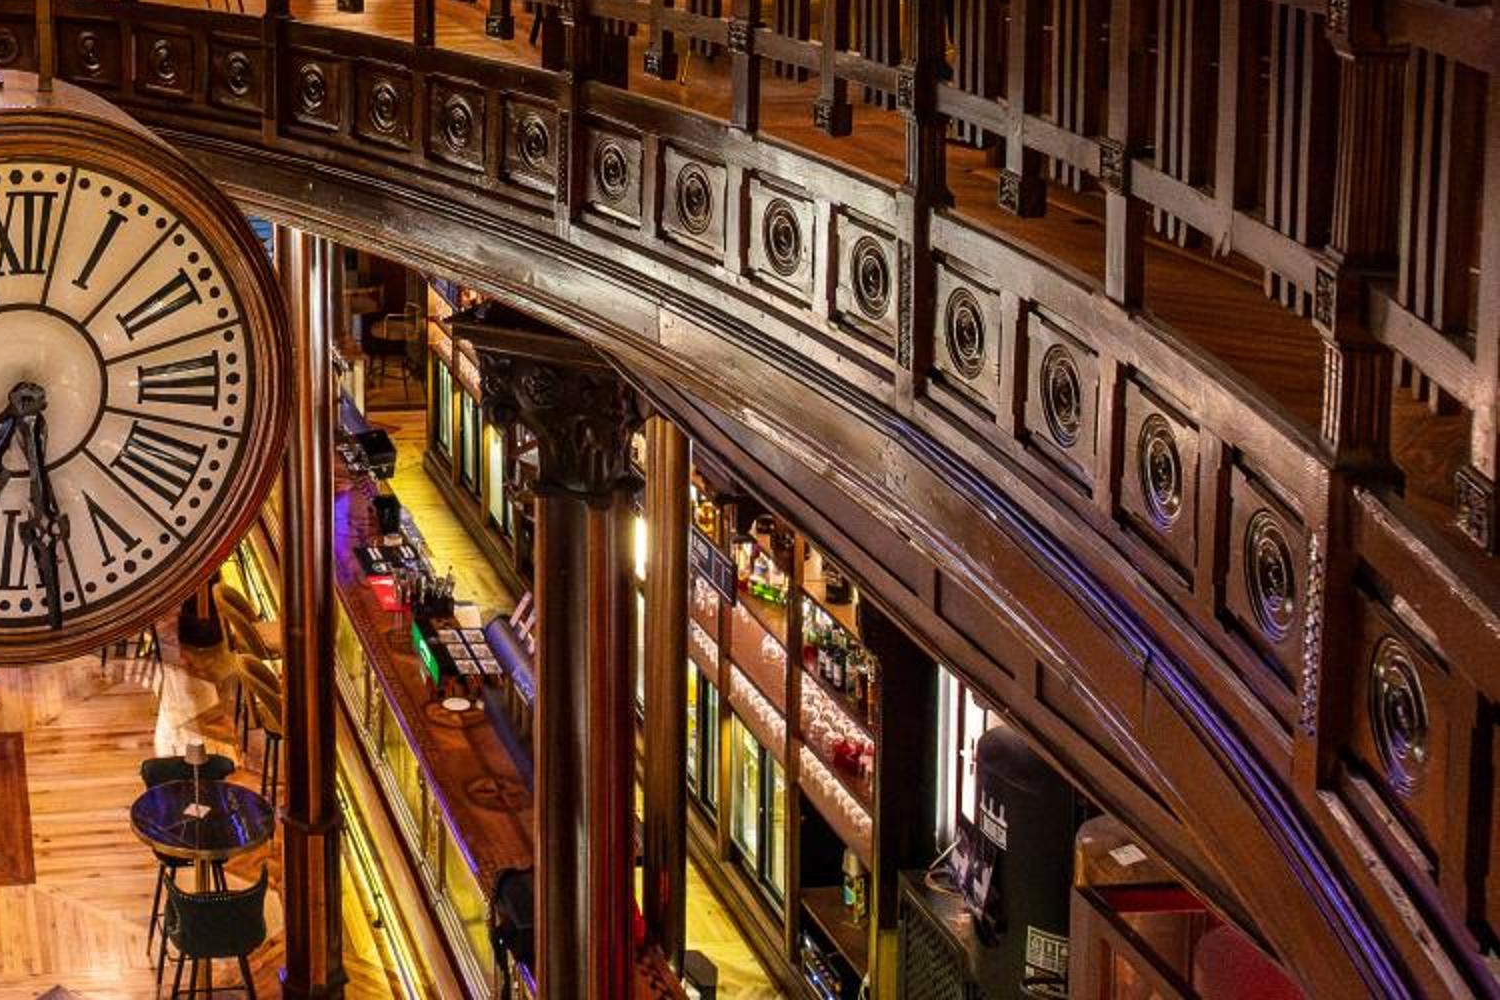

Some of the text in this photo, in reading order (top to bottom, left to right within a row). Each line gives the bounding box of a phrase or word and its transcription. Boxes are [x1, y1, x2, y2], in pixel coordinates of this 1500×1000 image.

[71, 209, 128, 290] I
[116, 267, 203, 341] II
[137, 350, 220, 411] III
[110, 419, 208, 510] IIII
[82, 490, 142, 567] V
